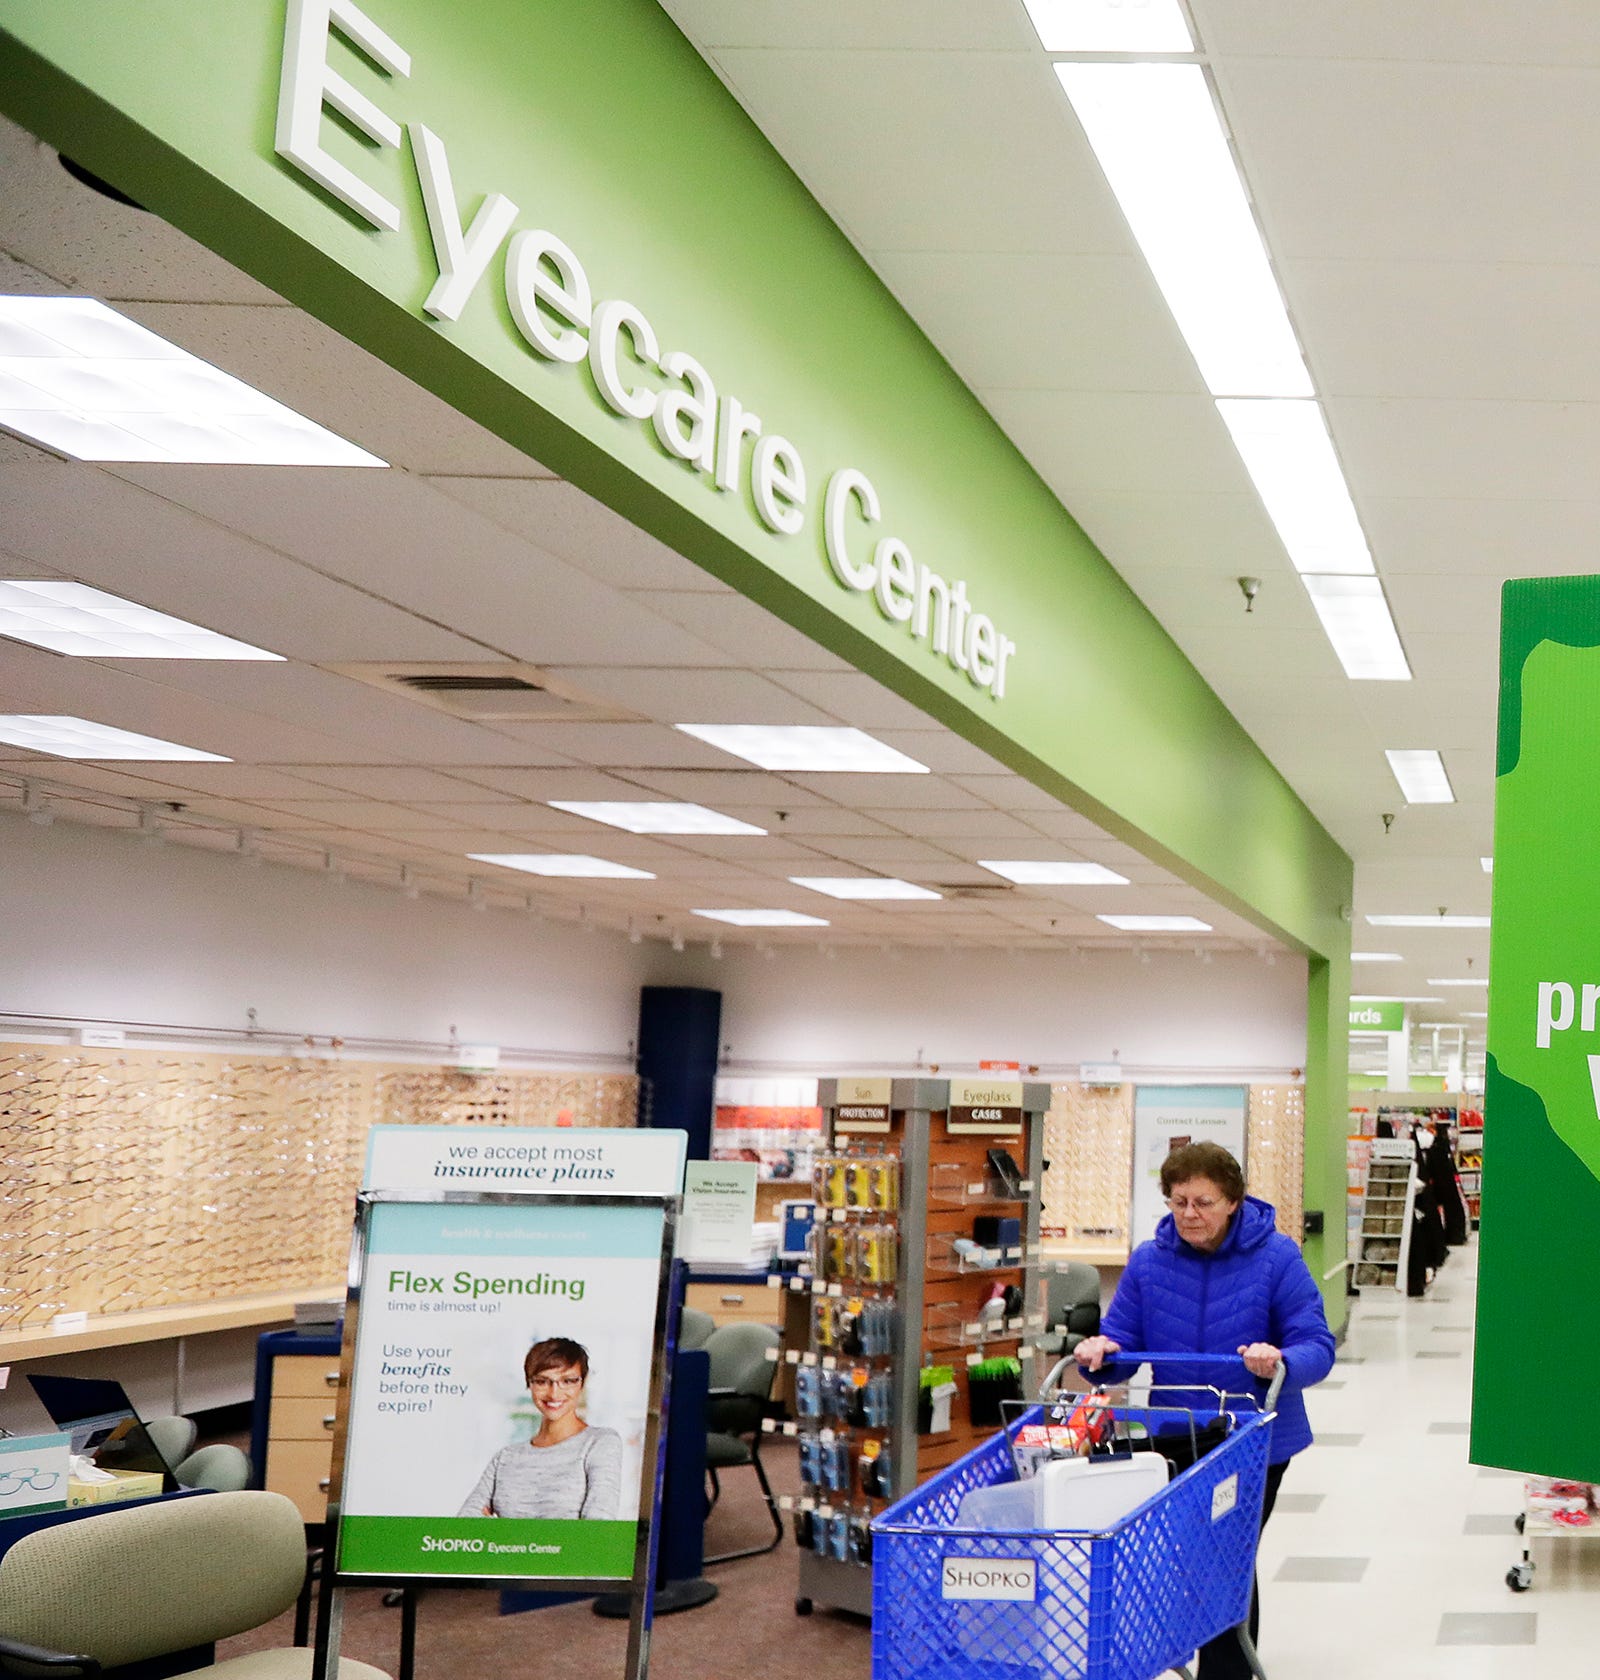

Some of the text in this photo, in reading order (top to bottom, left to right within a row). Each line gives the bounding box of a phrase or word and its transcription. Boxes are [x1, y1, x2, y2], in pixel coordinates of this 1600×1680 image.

[275, 0, 1017, 698] Eyecare Center
[854, 1087, 872, 1099] Sun
[963, 1089, 1012, 1103] Eyeglass
[838, 1108, 885, 1120] PROTECTION
[971, 1108, 1002, 1121] CASES
[1156, 1116, 1227, 1126] Contact Lenses
[449, 1145, 603, 1163] we accept most
[433, 1161, 616, 1184] insurance plans
[388, 1271, 585, 1300] Flex Spending
[388, 1300, 501, 1315] time is almost up!
[382, 1344, 453, 1362] Use your
[381, 1362, 451, 1379] benefits
[379, 1381, 468, 1397] before they
[378, 1400, 433, 1414] expire!
[421, 1535, 562, 1554] SHOPKO Eyecare Center
[945, 1567, 1031, 1588] SHOPKO
